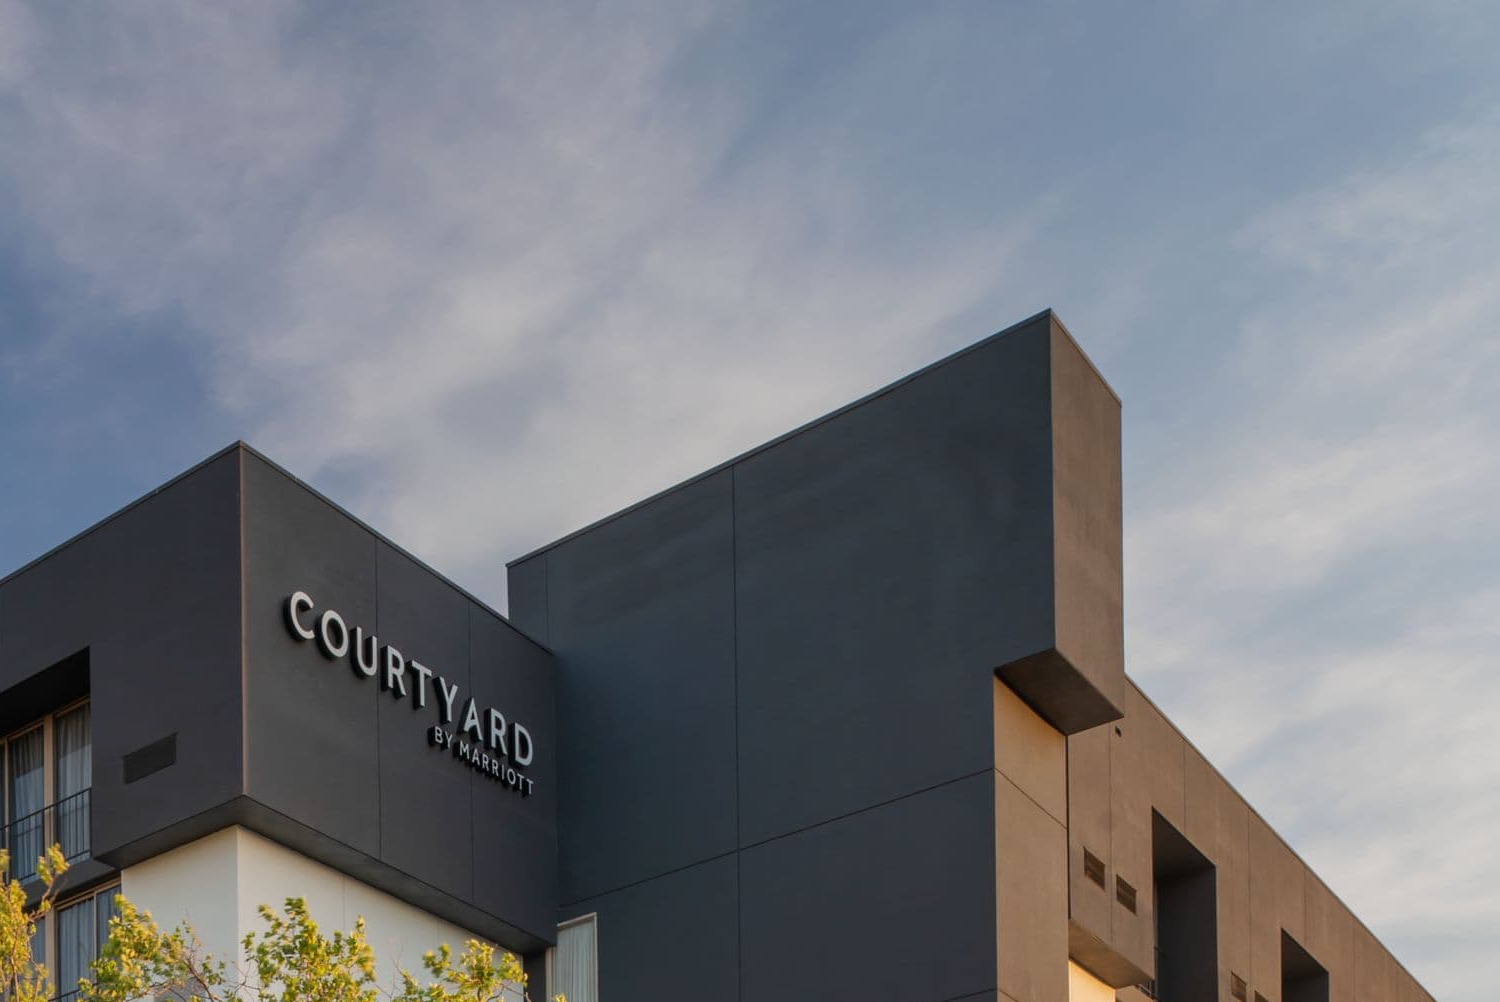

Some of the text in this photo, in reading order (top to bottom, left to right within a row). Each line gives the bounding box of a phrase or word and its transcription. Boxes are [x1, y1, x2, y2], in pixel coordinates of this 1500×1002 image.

[286, 591, 534, 767] COURTYARD
[433, 726, 535, 795] BY MARRIOTT
